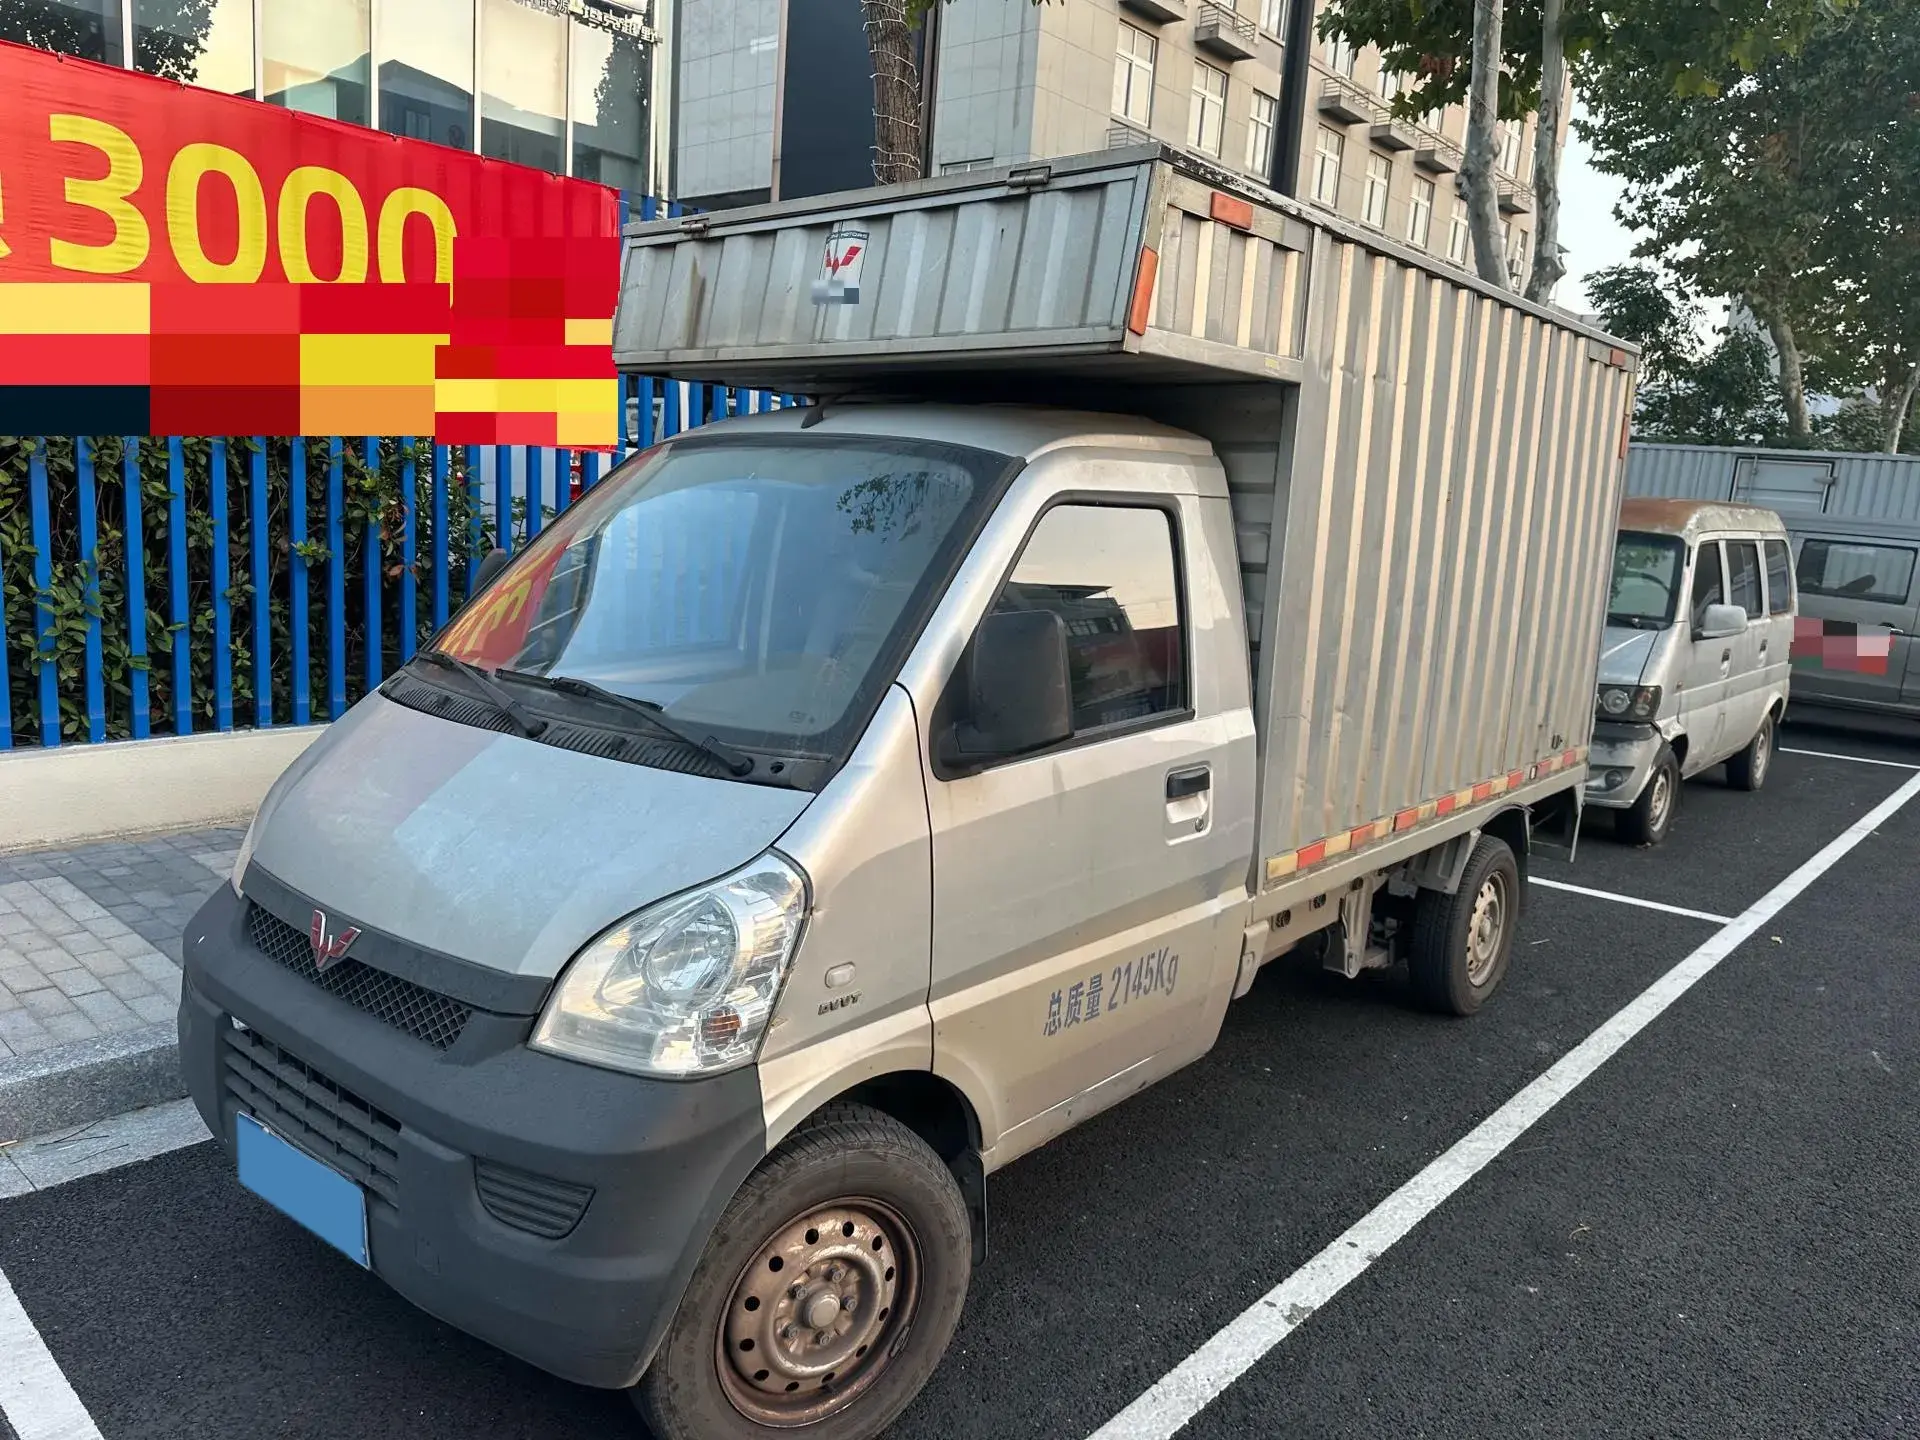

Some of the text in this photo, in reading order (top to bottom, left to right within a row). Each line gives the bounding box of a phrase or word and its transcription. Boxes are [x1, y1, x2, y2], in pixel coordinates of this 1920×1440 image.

[49, 113, 458, 286] 3000
[1043, 946, 1179, 1036] 总质量 2145Kg
